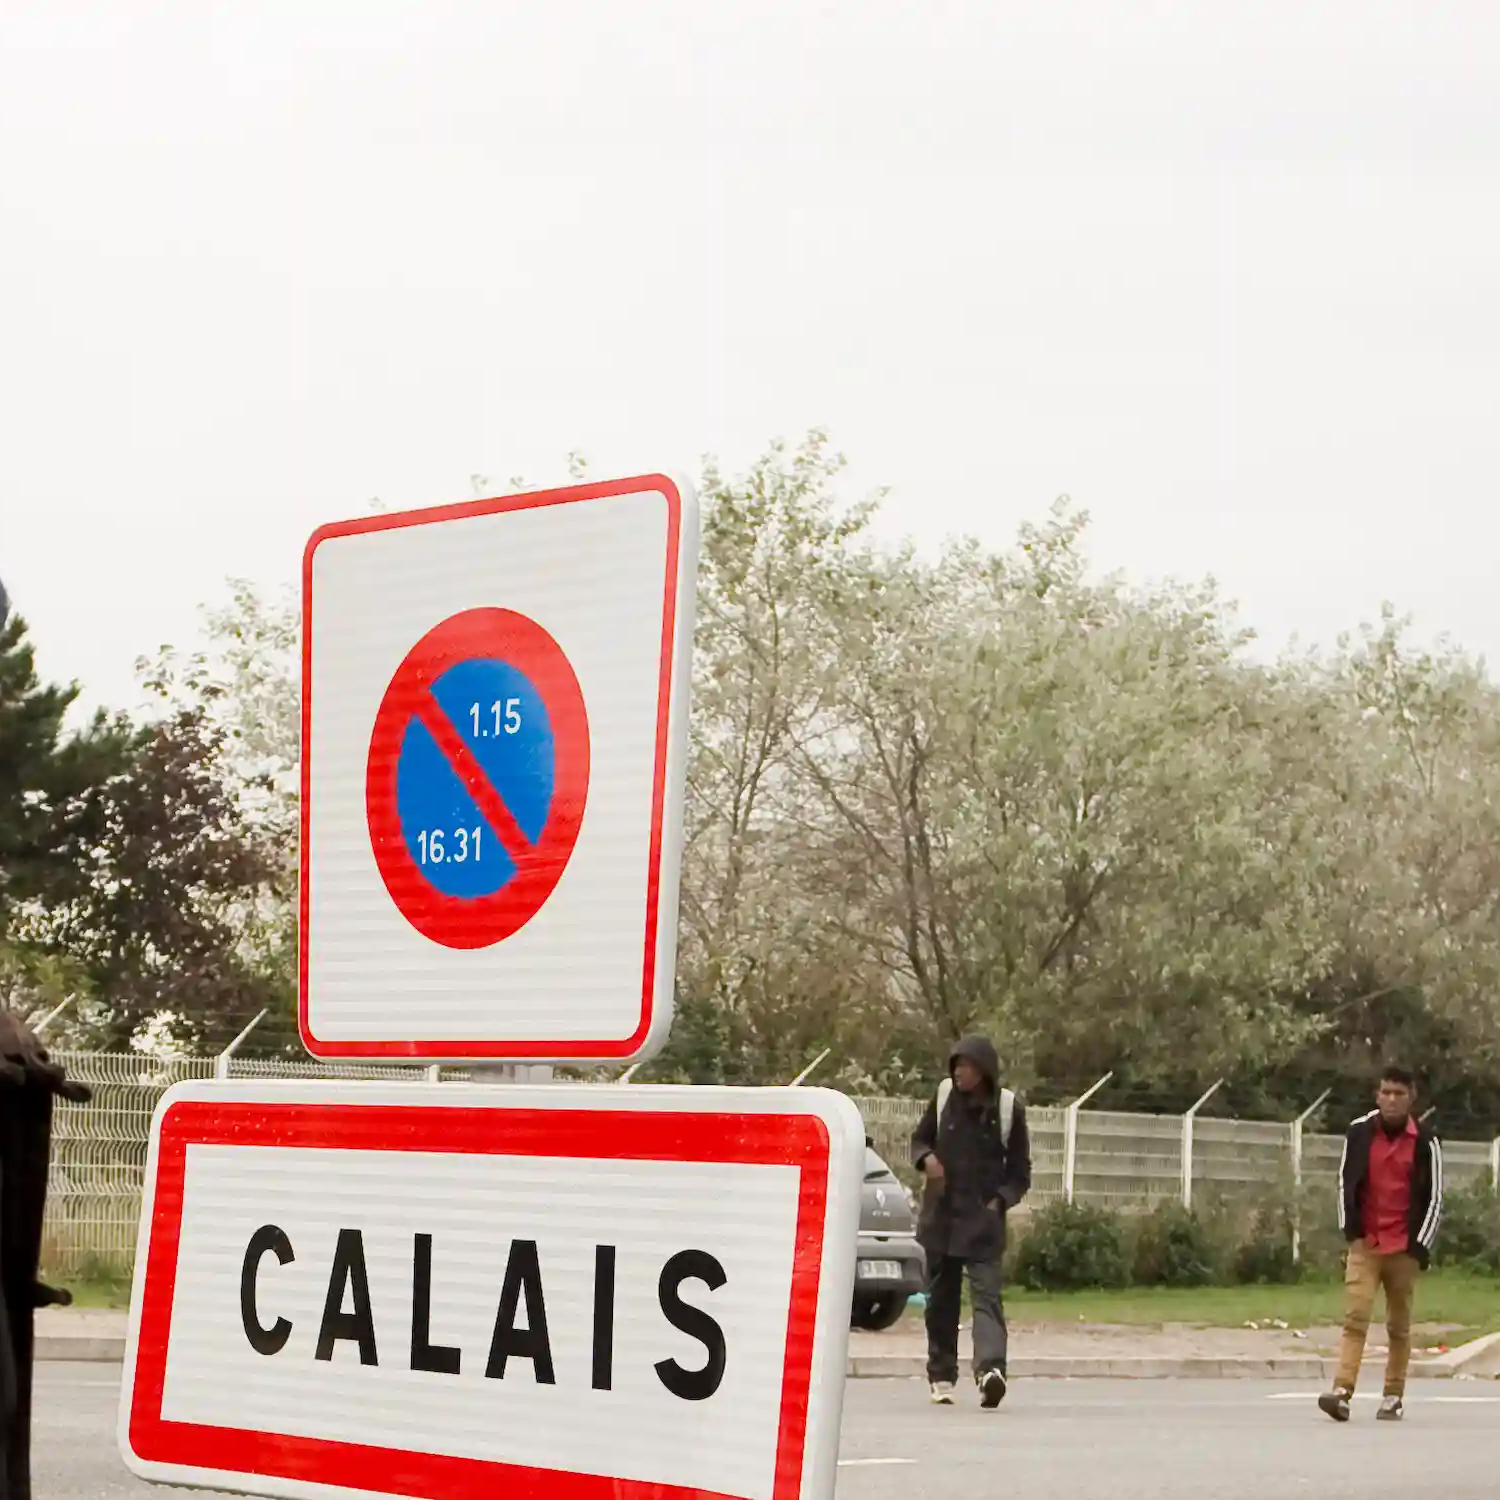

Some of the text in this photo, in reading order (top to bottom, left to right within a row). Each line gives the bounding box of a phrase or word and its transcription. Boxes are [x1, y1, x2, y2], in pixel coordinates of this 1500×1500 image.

[469, 698, 522, 737] 1.15
[417, 826, 482, 864] 16.31
[240, 1224, 728, 1401] CALAIS
